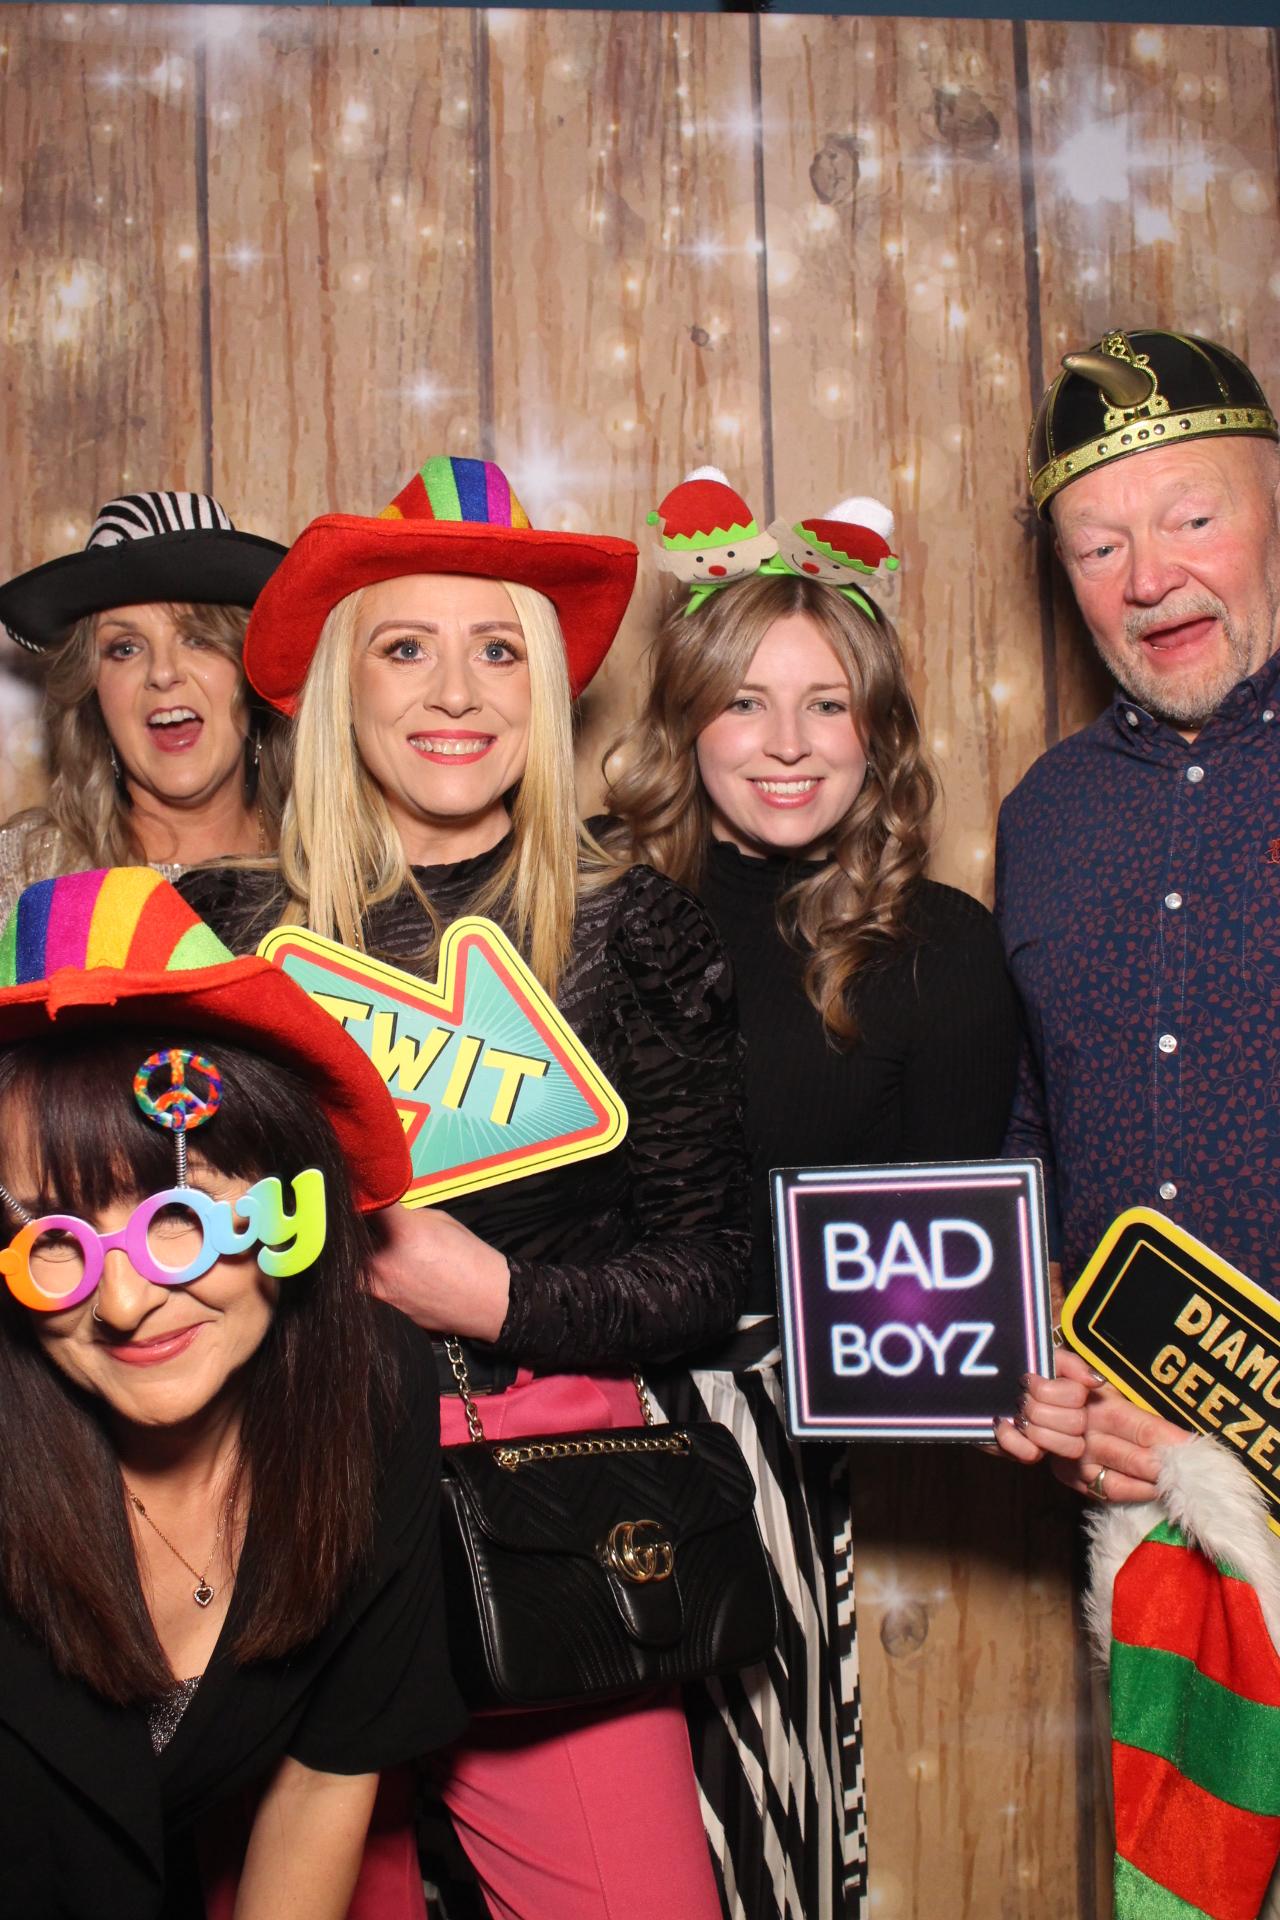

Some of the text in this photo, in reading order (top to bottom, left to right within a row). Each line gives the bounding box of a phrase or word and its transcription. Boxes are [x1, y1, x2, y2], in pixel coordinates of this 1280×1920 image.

[823, 1219, 993, 1293] BAD
[830, 1322, 999, 1377] BOYZ
[1150, 1344, 1280, 1482] GEEZE
